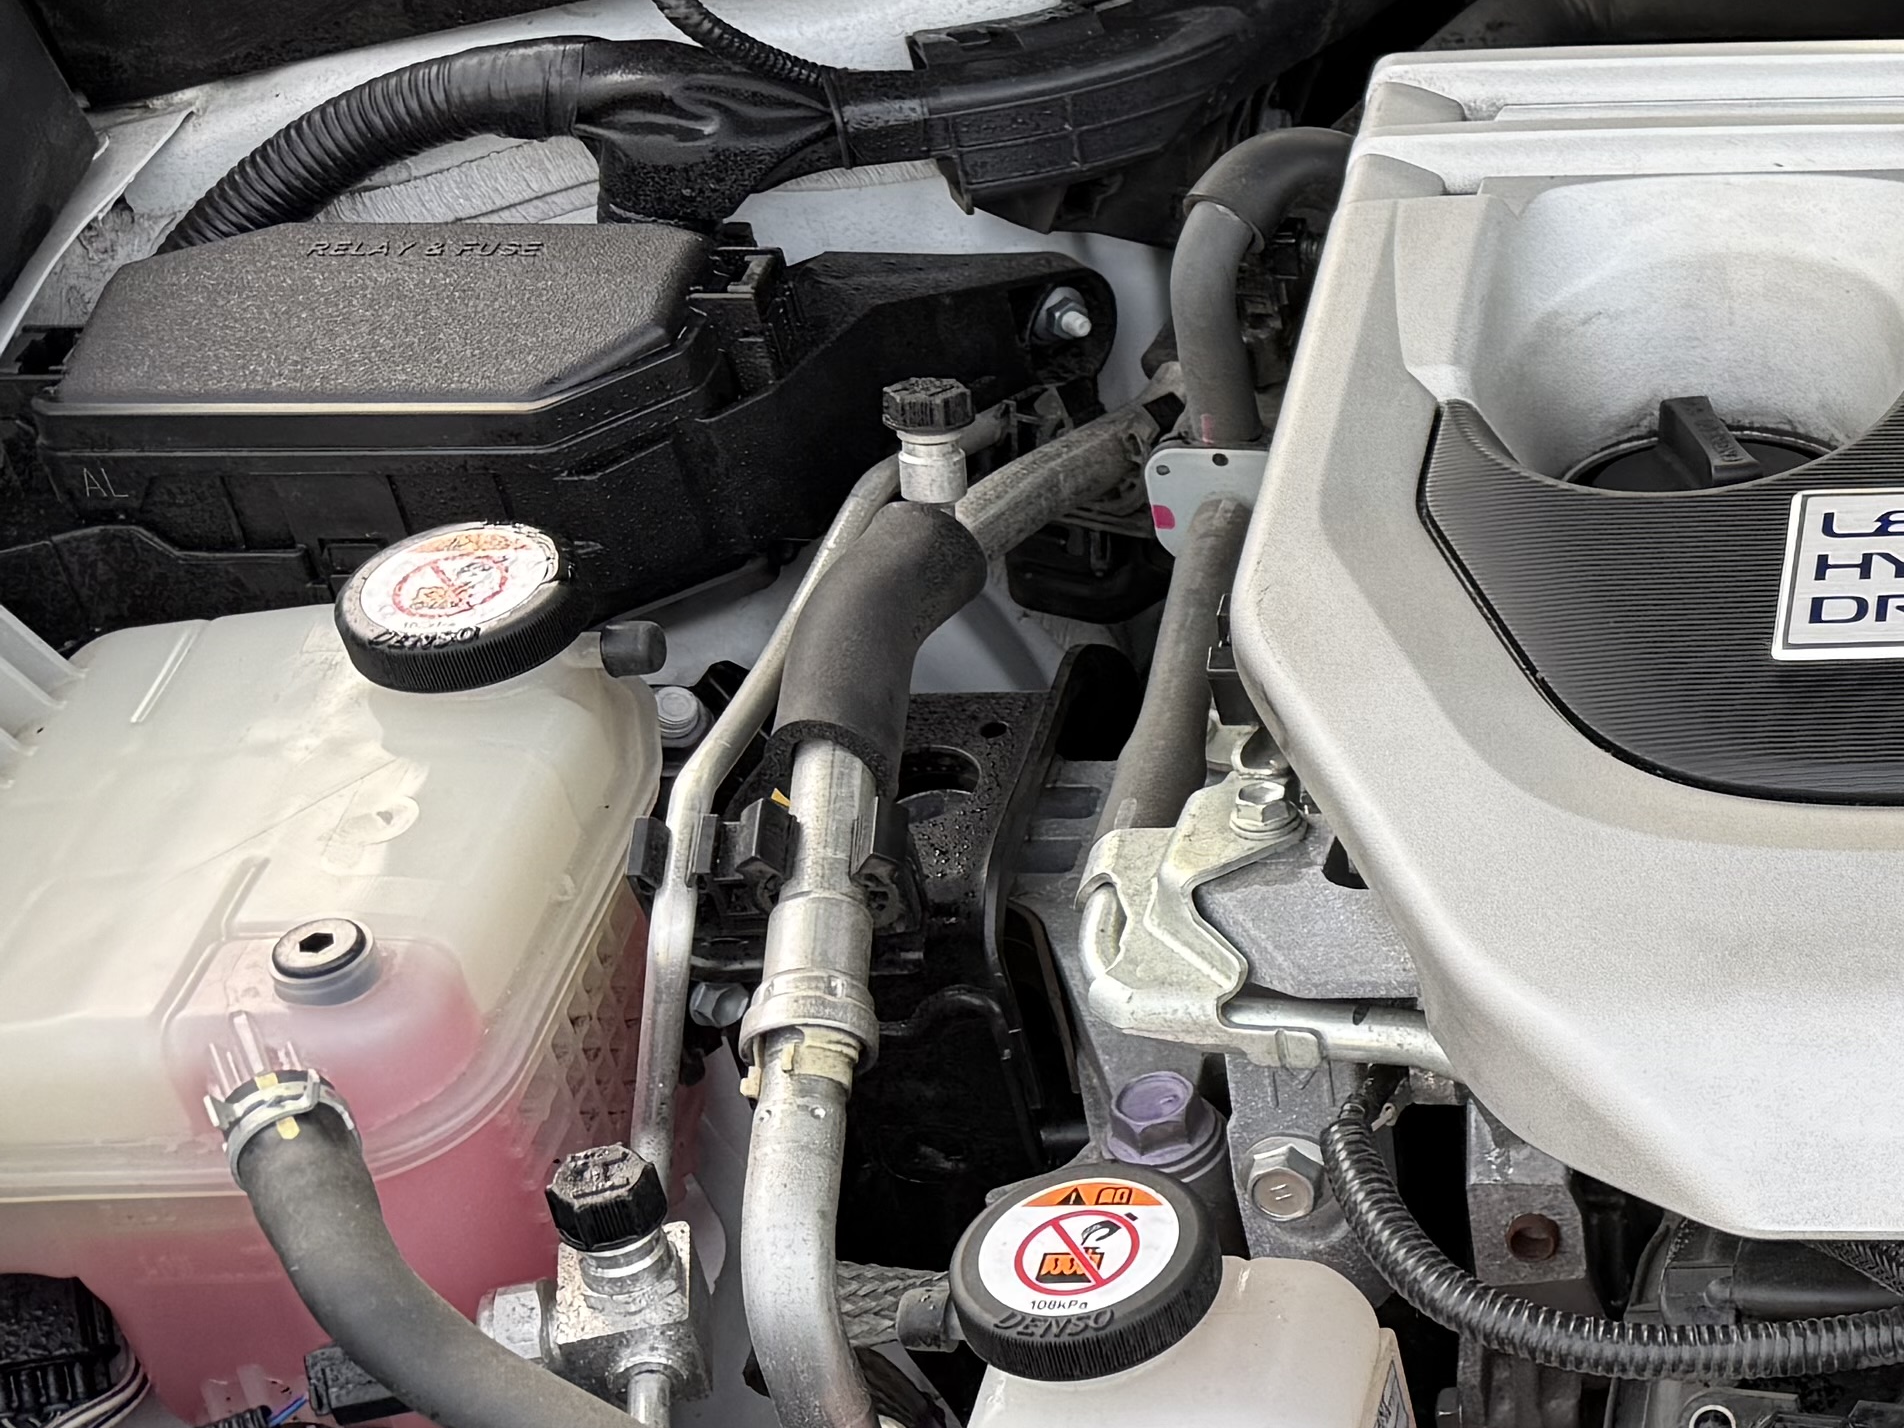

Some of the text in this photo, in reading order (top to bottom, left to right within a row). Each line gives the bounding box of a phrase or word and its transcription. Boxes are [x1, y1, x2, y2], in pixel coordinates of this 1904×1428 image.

[306, 239, 545, 258] RELAY & FUSE
[82, 467, 130, 500] AL
[993, 1308, 1115, 1339] DENSO
